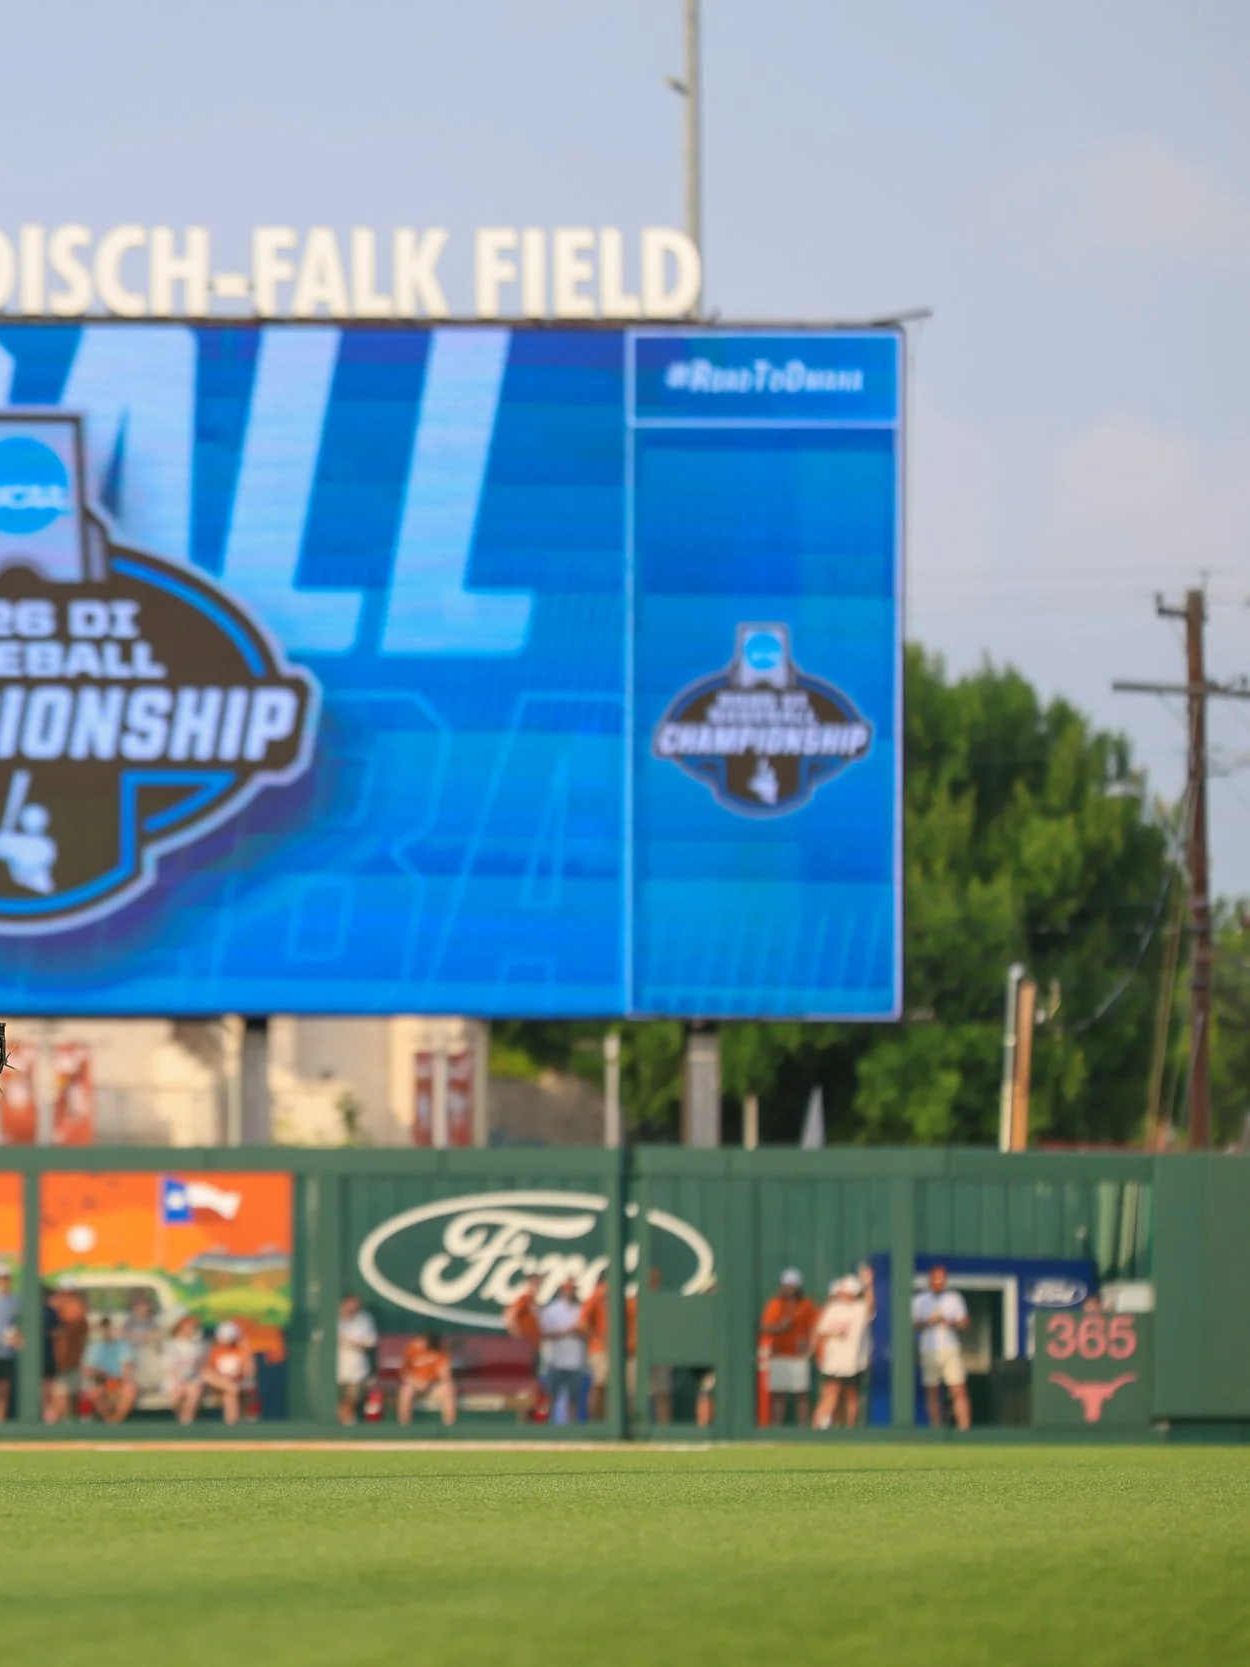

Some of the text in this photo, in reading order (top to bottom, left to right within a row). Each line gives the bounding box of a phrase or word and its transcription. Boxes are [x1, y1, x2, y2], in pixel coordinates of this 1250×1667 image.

[475, 226, 702, 320] FIELD
[68, 600, 140, 639] DI
[1046, 1312, 1138, 1360] 365
